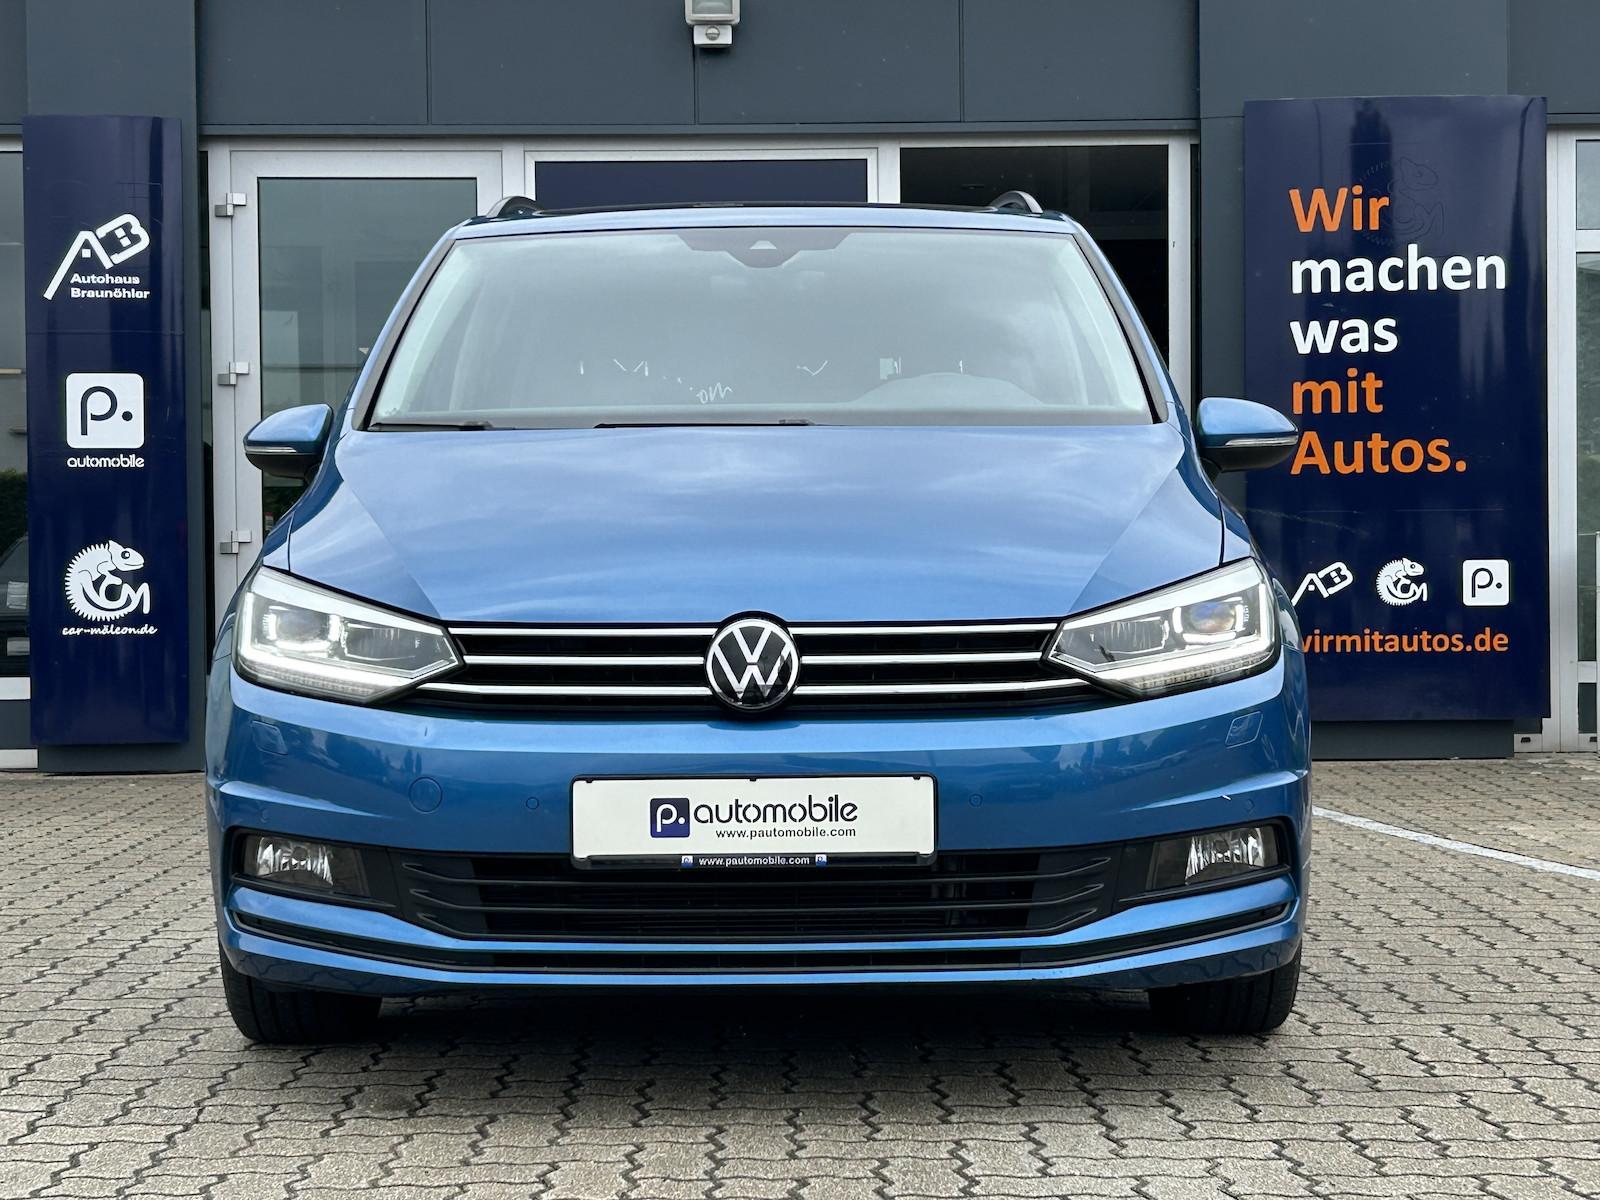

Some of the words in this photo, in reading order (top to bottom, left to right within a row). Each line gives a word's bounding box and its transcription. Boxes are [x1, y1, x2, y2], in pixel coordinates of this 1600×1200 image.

[1288, 185, 1390, 232] Wir
[70, 273, 140, 284] Autohaus
[1291, 243, 1506, 293] machen
[1290, 317, 1398, 354] was
[1292, 368, 1384, 415] mit
[67, 454, 145, 468] automobile
[1290, 431, 1467, 475] Autos.
[693, 794, 858, 824] automobile
[715, 826, 856, 839] www.pautomobile.com
[699, 855, 810, 867] www.pautomobile.com
